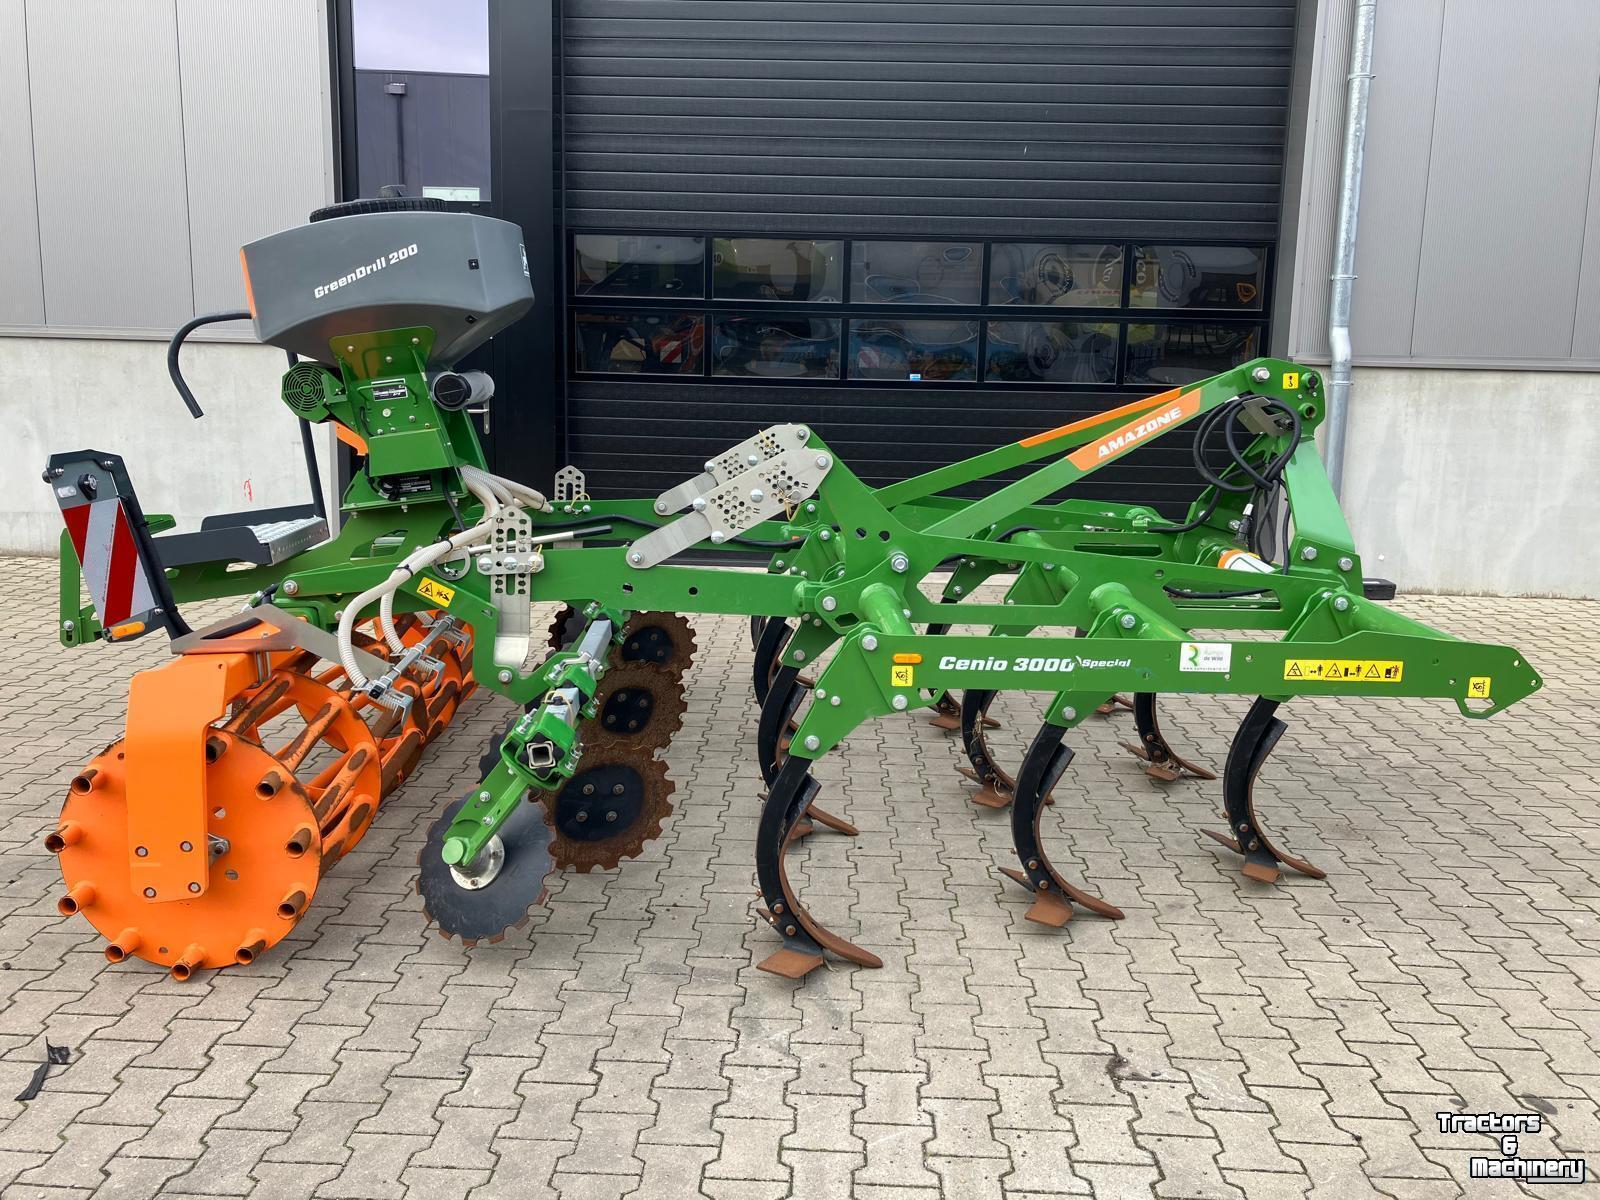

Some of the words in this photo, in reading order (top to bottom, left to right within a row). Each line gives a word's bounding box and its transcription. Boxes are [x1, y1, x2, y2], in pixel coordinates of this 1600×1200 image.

[313, 256, 387, 299] GreenDrill
[388, 243, 419, 265] 200
[1097, 406, 1183, 459] AMAZONE
[938, 656, 1008, 671] Cenio
[1012, 657, 1075, 672] 3000
[1080, 658, 1132, 669] Special
